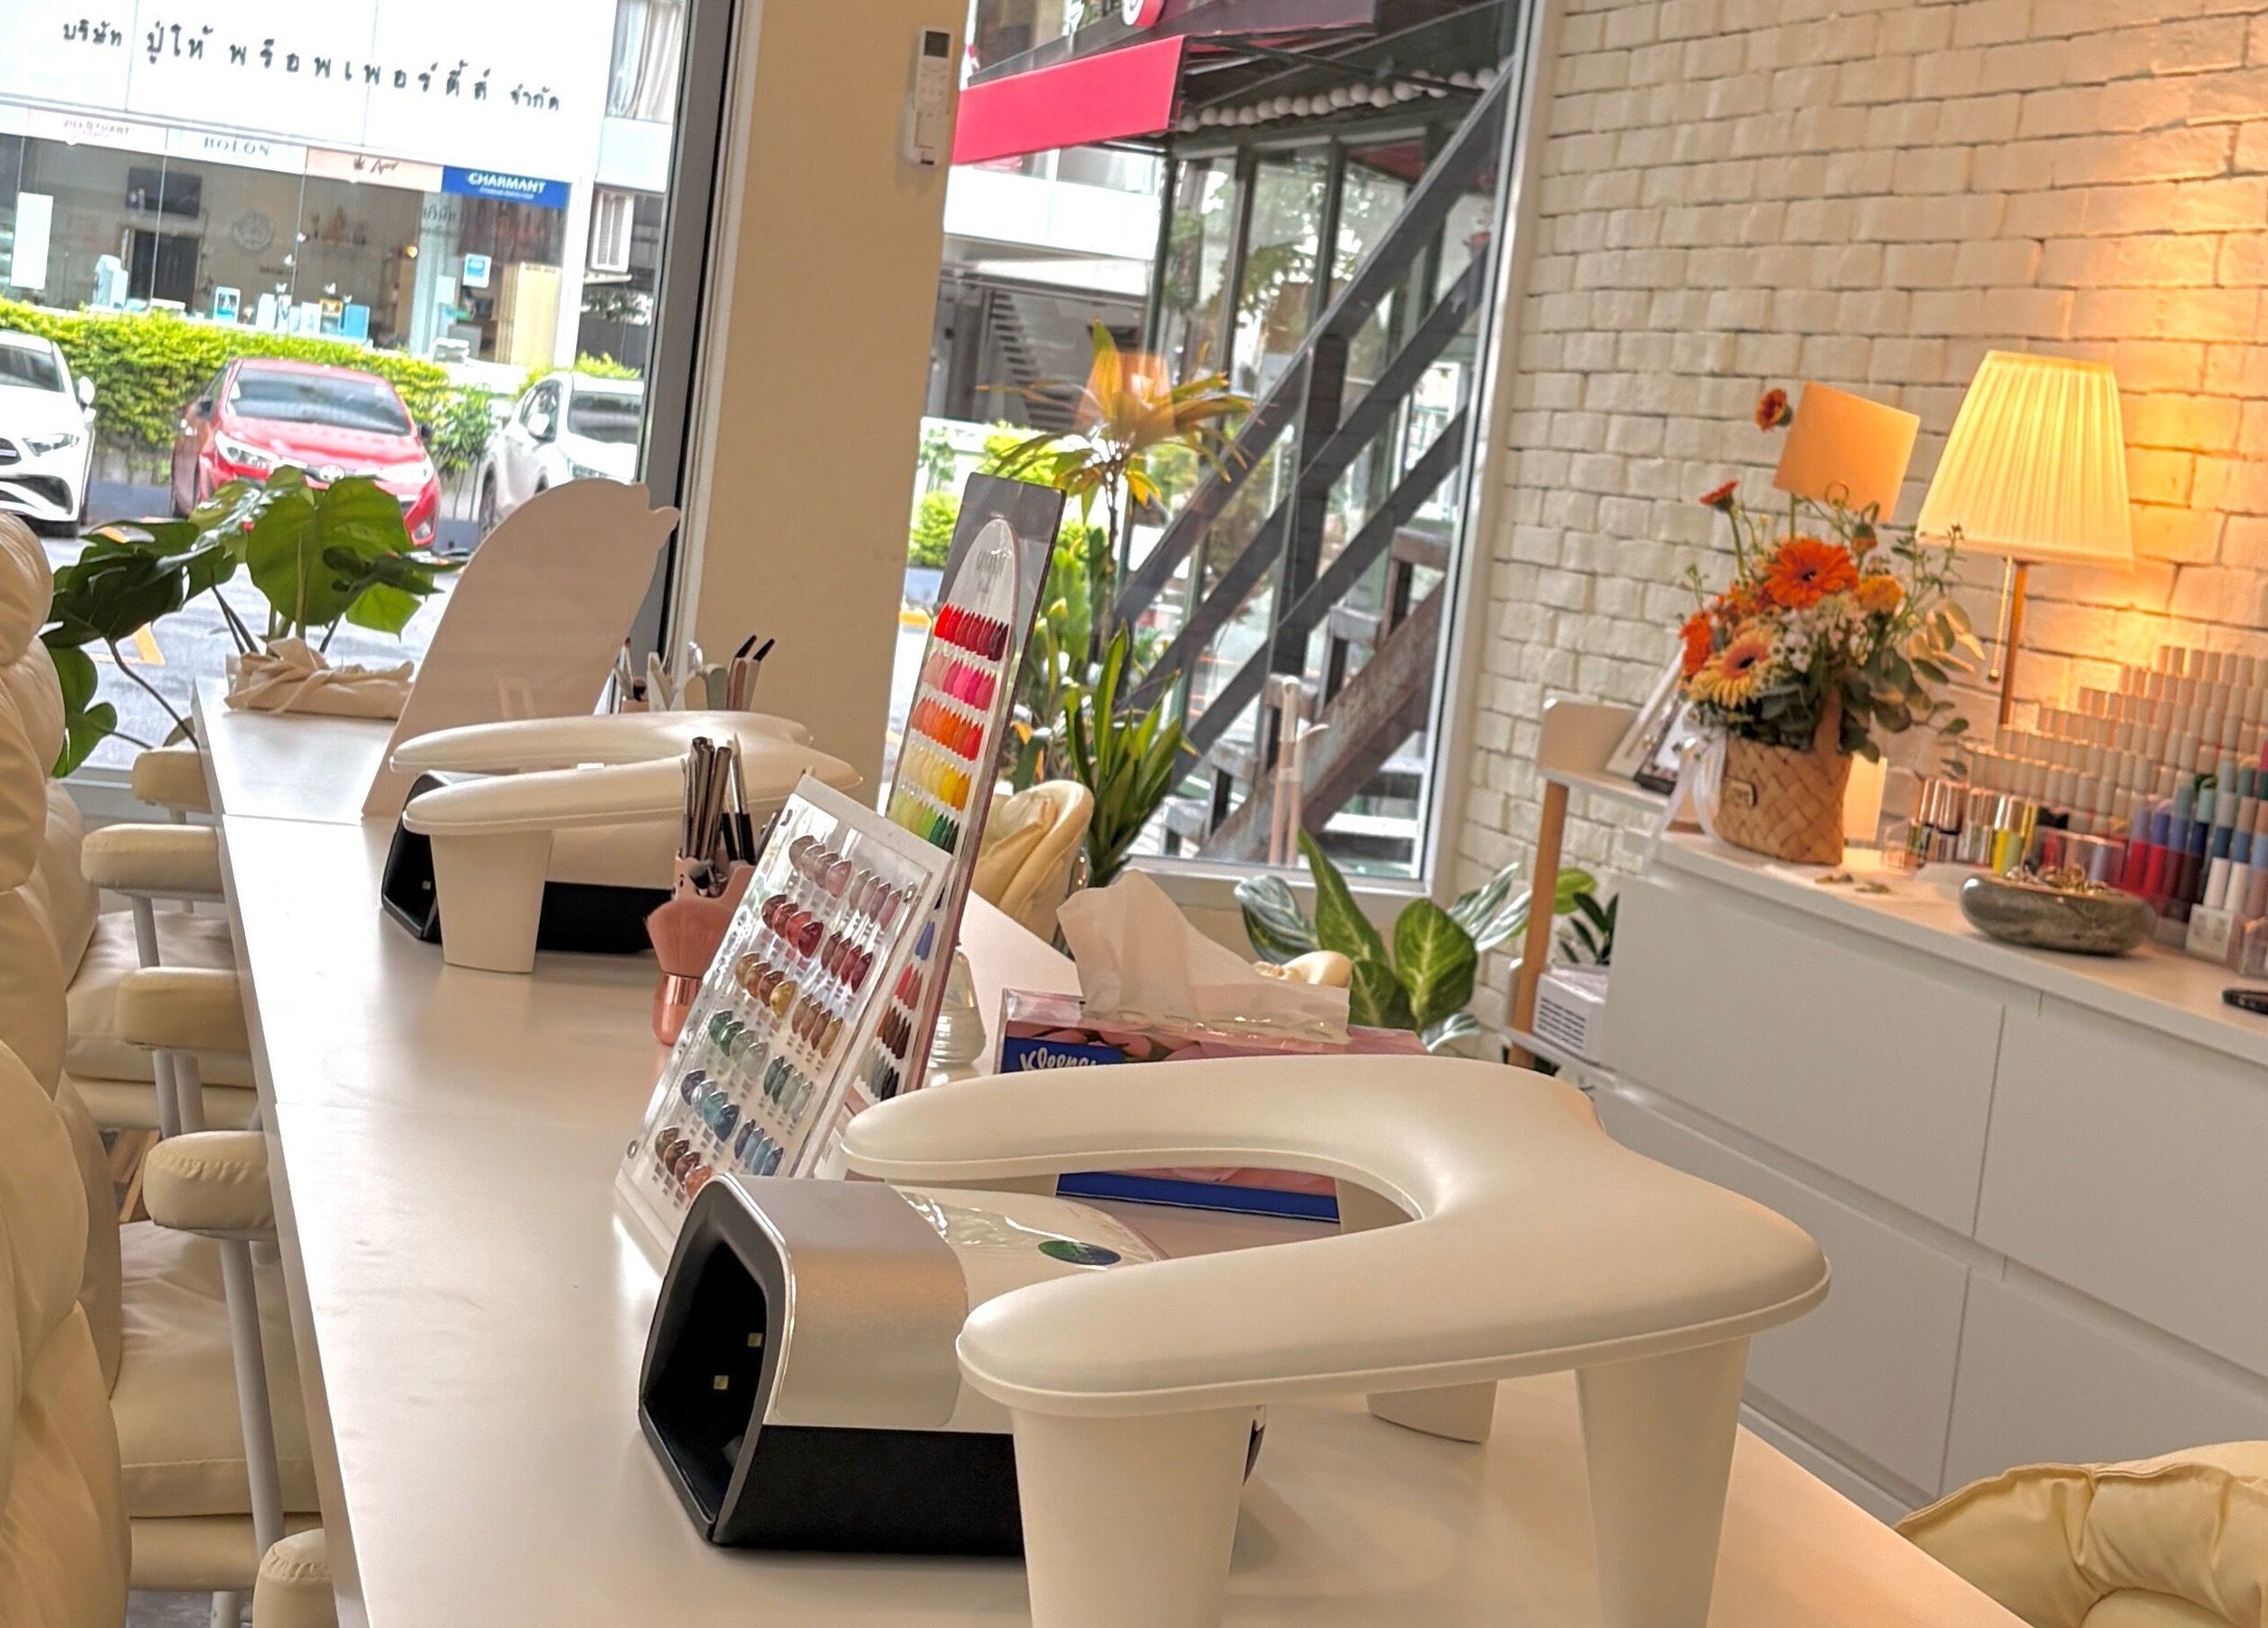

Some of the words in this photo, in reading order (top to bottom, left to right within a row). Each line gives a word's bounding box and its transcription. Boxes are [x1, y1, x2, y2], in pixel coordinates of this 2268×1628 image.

[61, 18, 123, 47] บริษัท
[509, 83, 560, 110] จำกัด
[467, 171, 546, 194] CHARMANT
